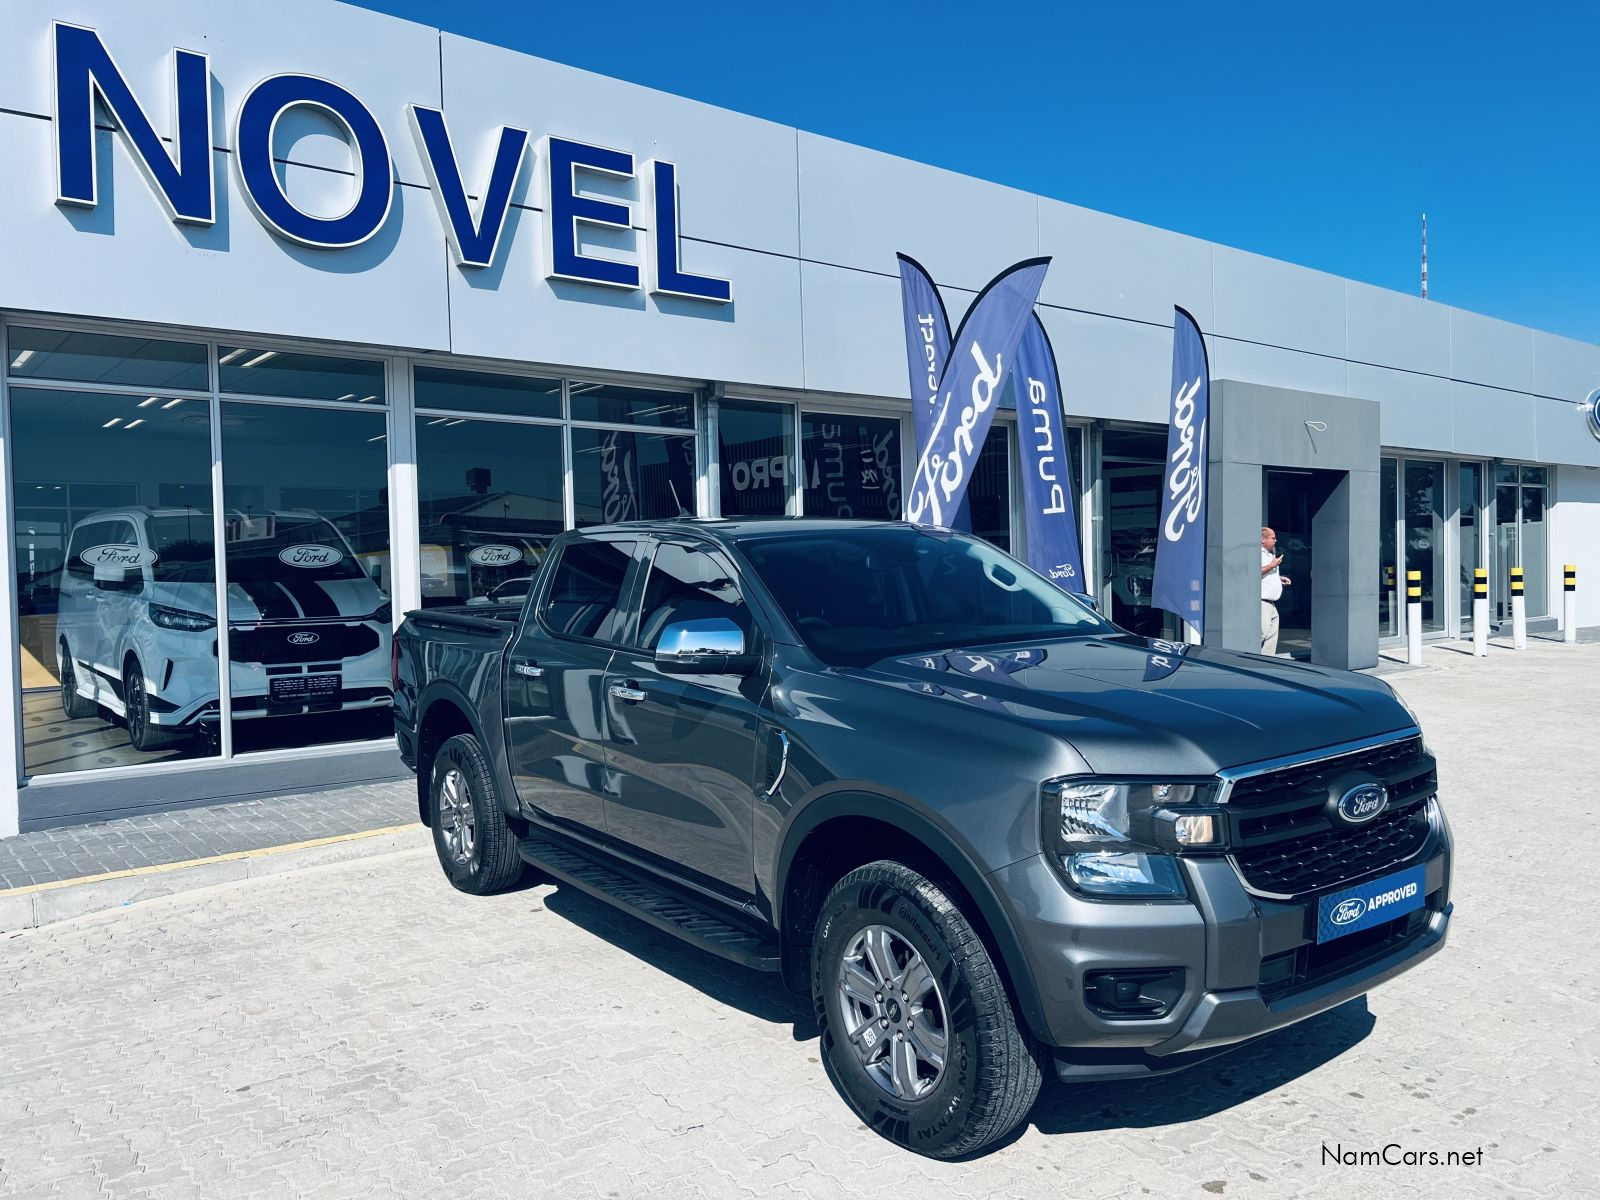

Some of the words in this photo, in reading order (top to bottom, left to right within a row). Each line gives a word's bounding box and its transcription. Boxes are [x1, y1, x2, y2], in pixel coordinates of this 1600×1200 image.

[51, 18, 733, 305] NOVEL
[902, 341, 1001, 526] Ford
[96, 543, 141, 565] Ford
[292, 543, 330, 564] Ford
[480, 547, 511, 563] Ford
[293, 633, 314, 643] Ford
[1353, 792, 1379, 815] Ford
[1336, 901, 1361, 922] Ford
[1367, 882, 1418, 912] APPROVED
